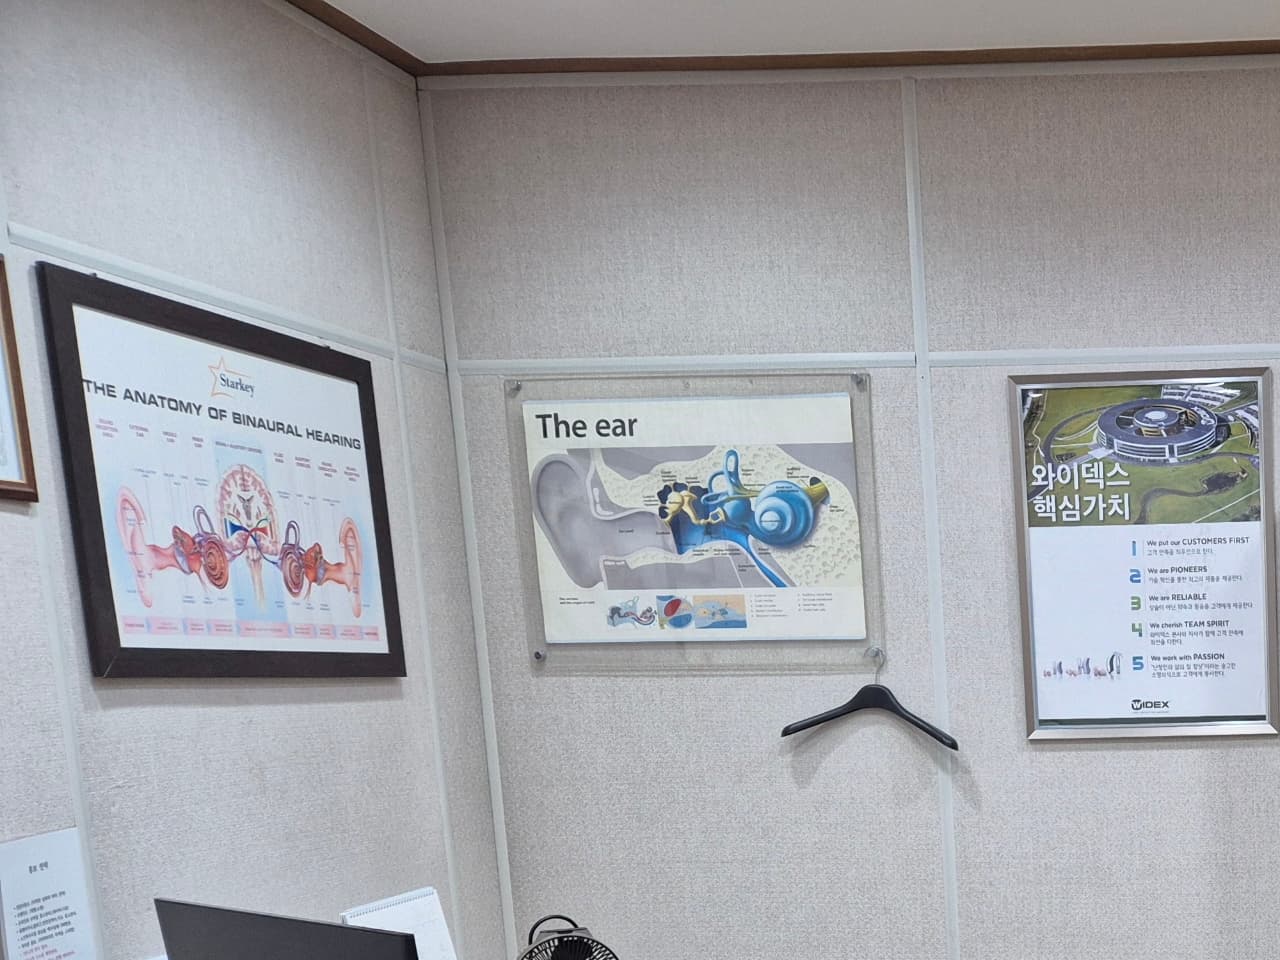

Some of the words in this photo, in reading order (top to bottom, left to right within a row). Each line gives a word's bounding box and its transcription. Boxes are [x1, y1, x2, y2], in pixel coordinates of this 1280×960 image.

[219, 373, 255, 398] Starkey
[82, 379, 117, 398] THE
[123, 388, 202, 417] ANATOMY
[208, 406, 227, 421] OF
[232, 412, 302, 438] BINAURAL
[306, 428, 361, 450] HEARING
[535, 413, 587, 439] The
[595, 416, 638, 438] ear
[1031, 462, 1130, 490] 와이덱스
[1033, 493, 1130, 522] 핵심가치
[1132, 541, 1137, 556] 1
[1182, 537, 1228, 546] CUSTOMERS
[1229, 536, 1250, 544] FIRST
[1130, 569, 1142, 584] 2
[1170, 565, 1208, 574] PIONEERS
[1131, 596, 1142, 611] 3
[1171, 593, 1207, 601] RELIABLE
[1131, 623, 1143, 637] 4
[1184, 620, 1205, 628] TEAM
[1132, 656, 1145, 671] 5
[1193, 653, 1225, 661] PASSION
[1131, 699, 1170, 711] WIDEX
